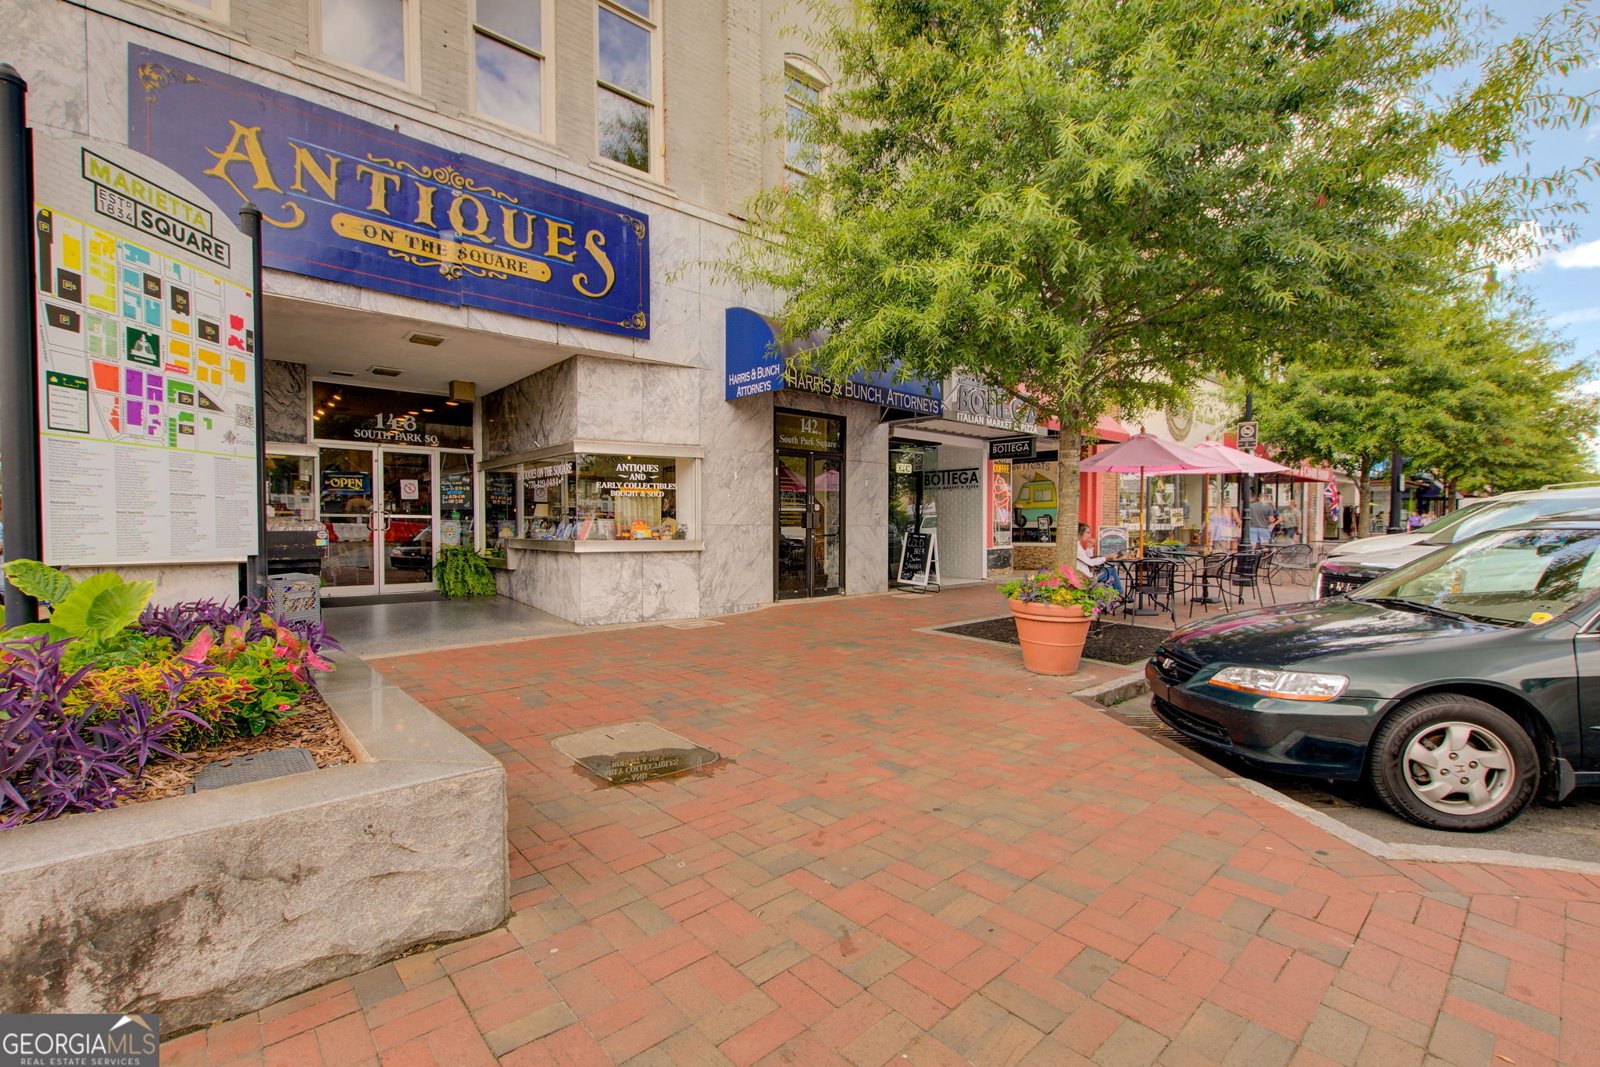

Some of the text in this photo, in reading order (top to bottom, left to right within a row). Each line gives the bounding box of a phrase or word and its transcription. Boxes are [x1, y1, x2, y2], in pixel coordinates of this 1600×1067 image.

[89, 158, 207, 230] MARIETTA
[99, 200, 132, 222] 1834
[203, 119, 616, 298] ANTIQUES
[141, 209, 225, 261] SQUARE
[363, 225, 529, 274] ON THE SQUARE
[729, 363, 780, 386] HARRIS & BUNCH
[736, 380, 772, 398] ATTORNEYS
[787, 369, 832, 394] HARRIS
[887, 387, 939, 414] ATTORNEYS
[375, 412, 418, 432] 146
[957, 412, 986, 425] ITALIAN
[986, 416, 1013, 431] MARKET
[1020, 423, 1038, 434] PIZZA
[354, 428, 391, 440] SOUTH
[395, 430, 422, 443] PARK
[780, 434, 837, 449] South Park Square
[993, 441, 1030, 454] BOTTEGA
[616, 463, 659, 473] ANTIQUES
[629, 473, 646, 481] AND
[924, 468, 979, 487] BOTTEGA
[325, 477, 363, 491] OPEN
[623, 481, 677, 490] COLLECTIBLES
[647, 490, 664, 498] SOLD
